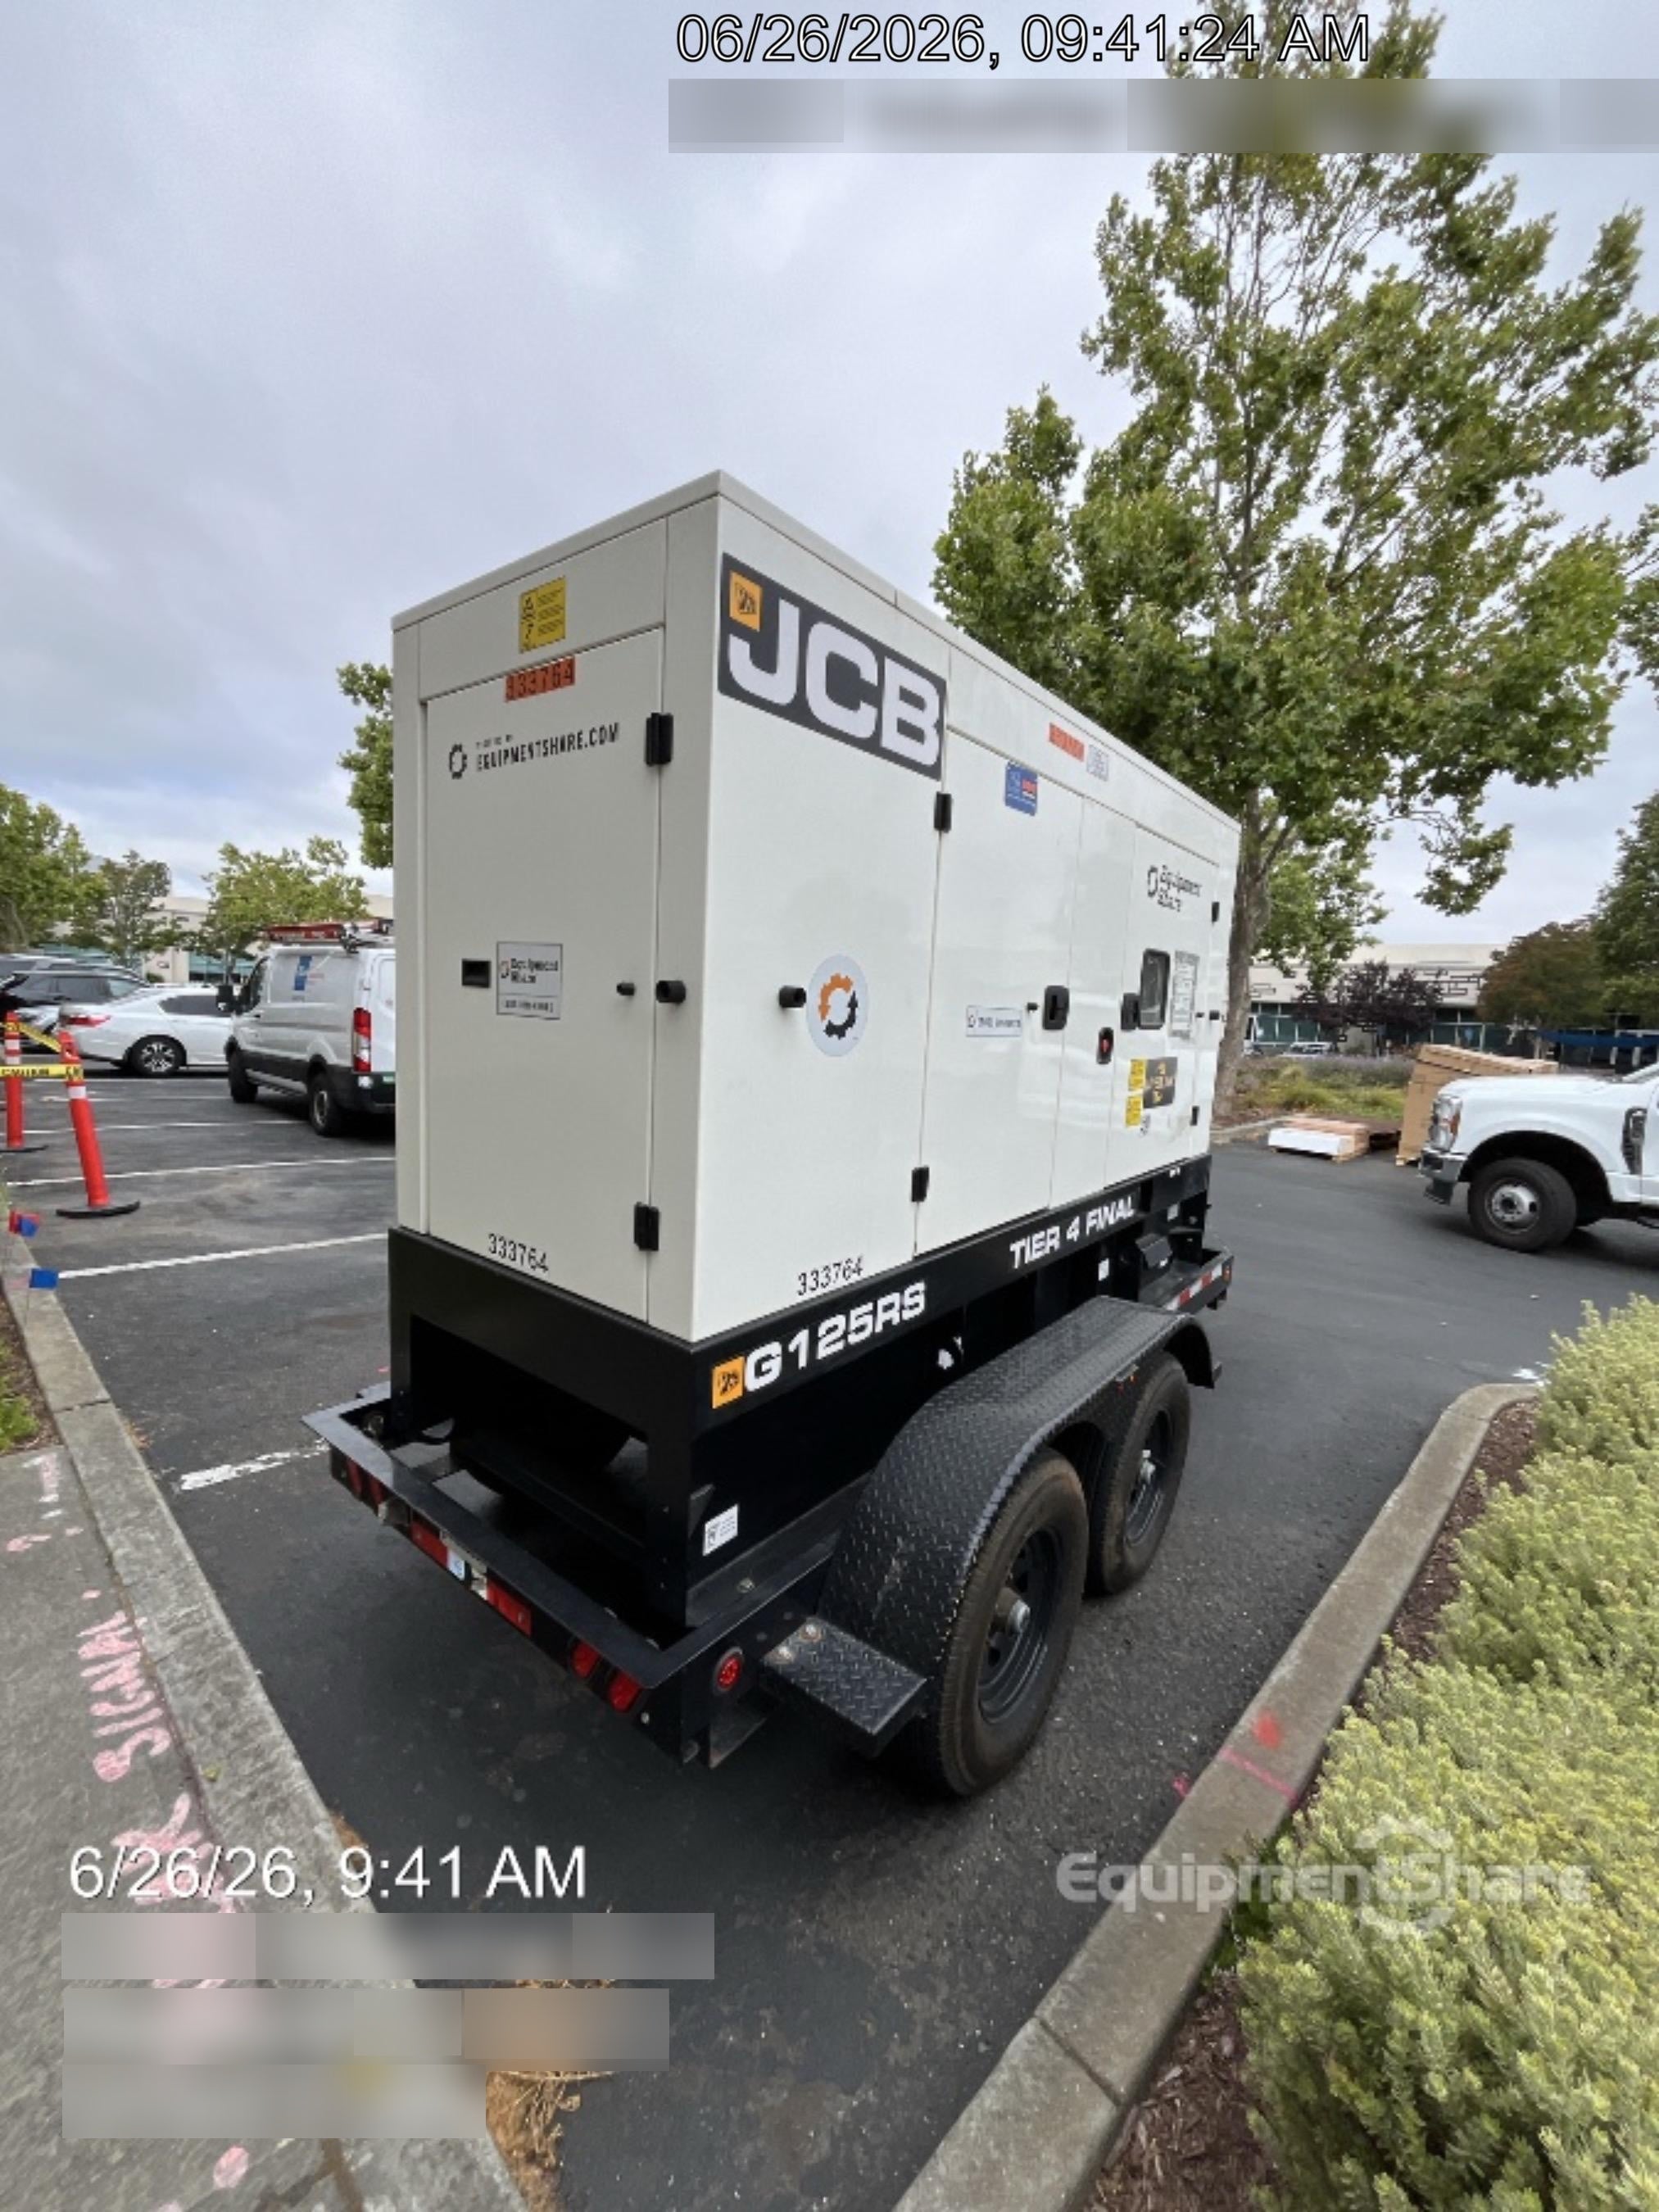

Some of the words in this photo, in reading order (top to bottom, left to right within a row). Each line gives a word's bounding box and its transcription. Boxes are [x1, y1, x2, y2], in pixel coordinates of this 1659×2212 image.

[505, 658, 574, 701] 333764
[729, 597, 940, 766] JCB
[488, 1233, 549, 1273] 333764
[1010, 1226, 1061, 1269] TIER
[1067, 1216, 1080, 1241] 4
[1086, 1195, 1135, 1235] FINAL
[797, 1256, 863, 1296] 333764
[745, 1280, 925, 1391] G125RS
